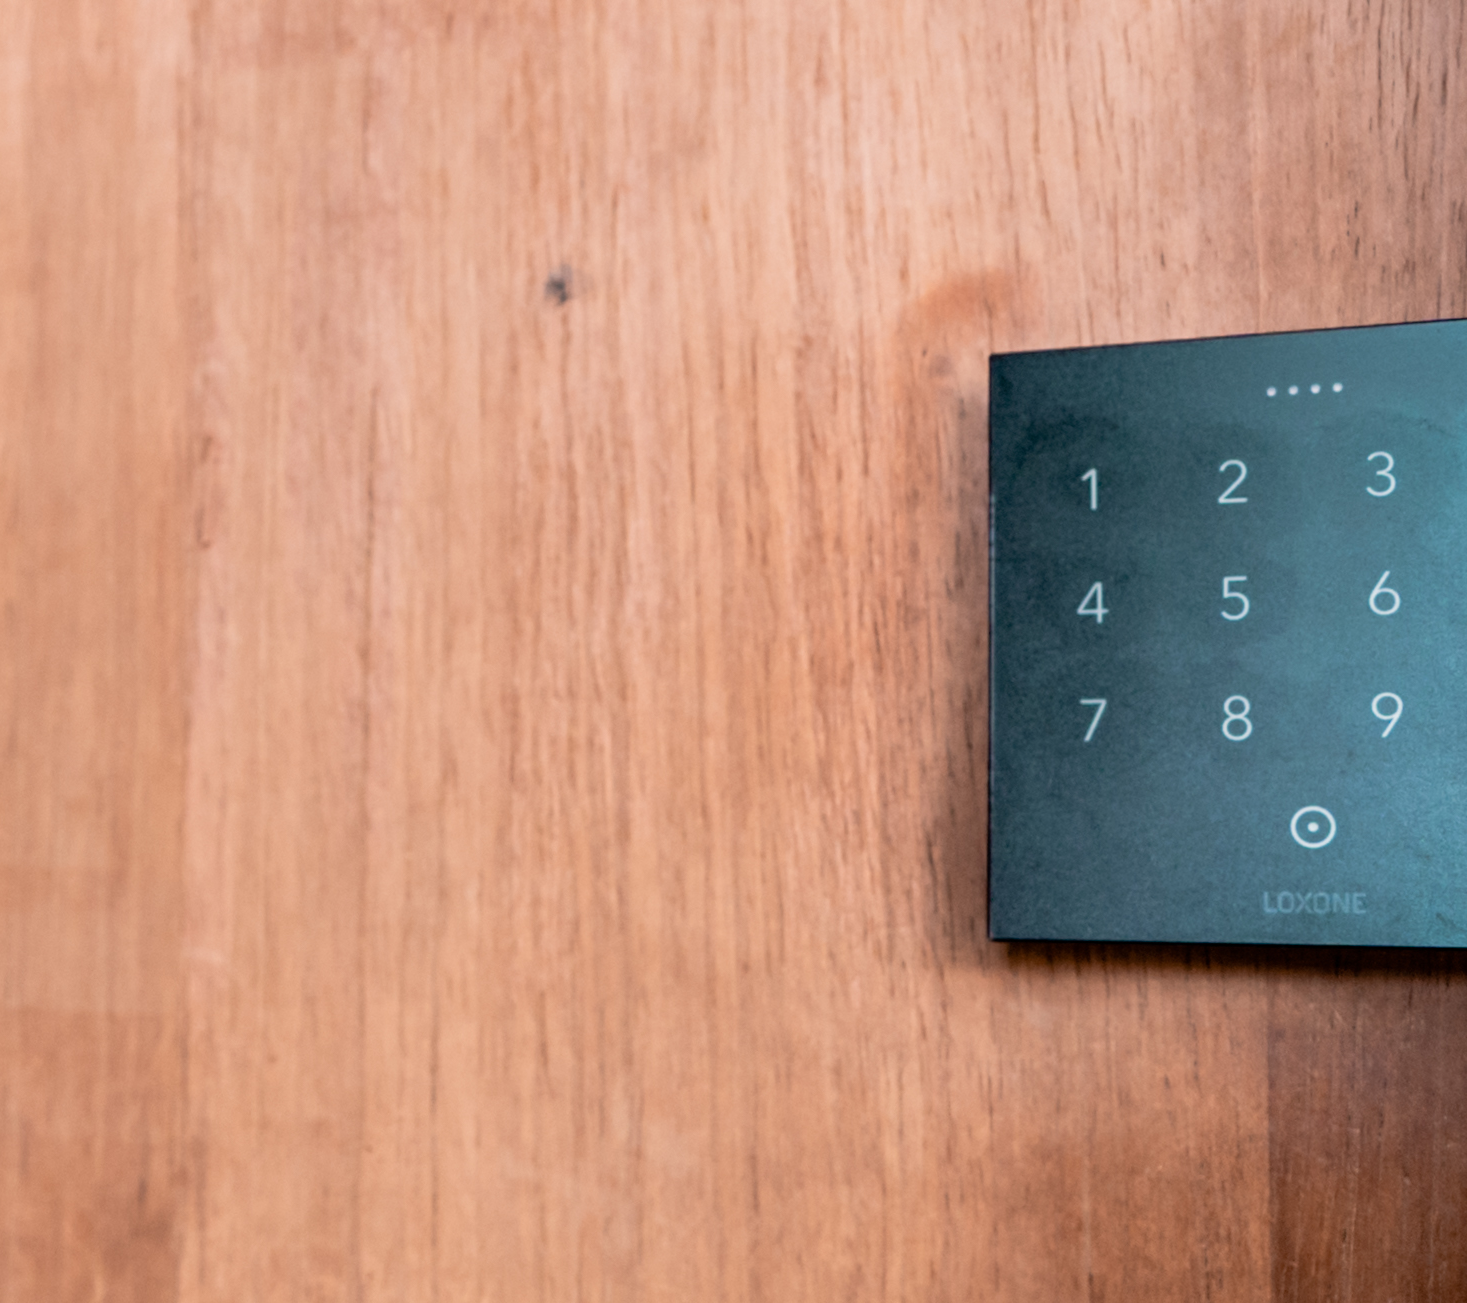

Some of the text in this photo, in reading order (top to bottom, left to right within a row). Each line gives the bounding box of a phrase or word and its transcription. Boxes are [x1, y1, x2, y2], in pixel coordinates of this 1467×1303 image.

[1079, 450, 1398, 512] 1 2 3
[1075, 581, 1110, 625] 4
[1219, 575, 1252, 622] 5
[1367, 570, 1402, 616] 6
[1079, 691, 1405, 743] 7 8 9
[1262, 889, 1368, 916] LOXONE
